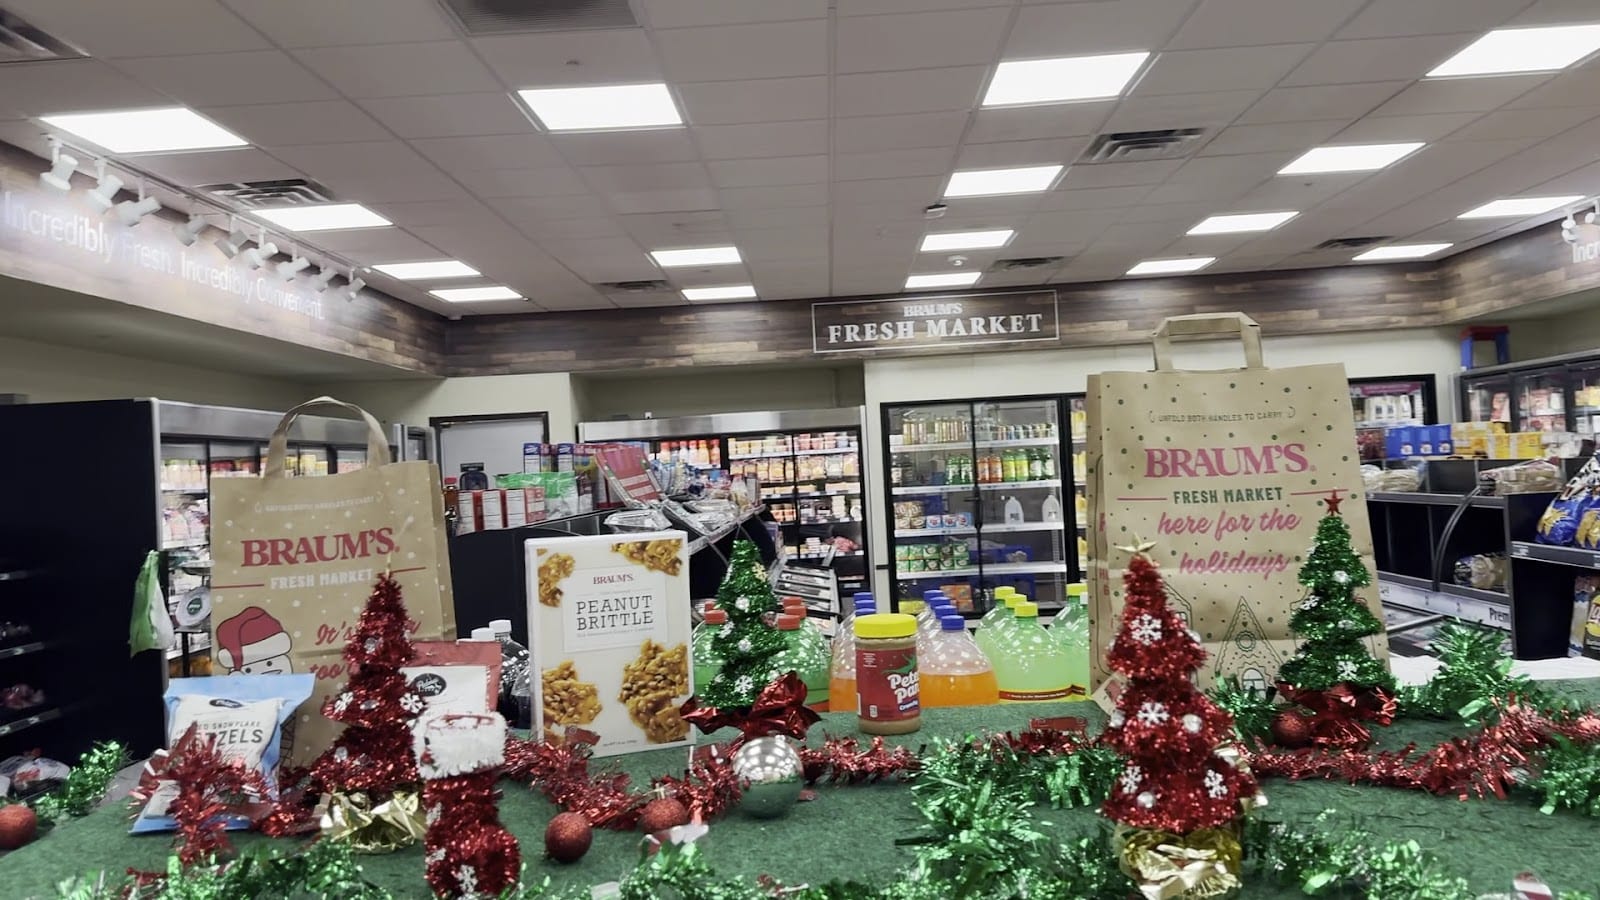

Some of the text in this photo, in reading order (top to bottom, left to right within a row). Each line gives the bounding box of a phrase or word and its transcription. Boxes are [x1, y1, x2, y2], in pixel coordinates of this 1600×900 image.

[4, 191, 114, 264] Incredibly
[181, 252, 253, 304] Incredibly
[904, 303, 963, 317] BRAUM'S
[828, 314, 1043, 343] FRESH MARKET
[1187, 414, 1206, 422] BOTH
[1208, 414, 1242, 422] HANDLES
[1144, 443, 1308, 478] BRAUM'S
[1173, 487, 1283, 504] FRESH MARKET
[1158, 507, 1302, 541] here for the
[241, 527, 394, 567] BRAUM'S
[1179, 549, 1290, 580] holidays
[270, 569, 373, 589] FRESH MARKET
[593, 573, 633, 585] BRAUM'S
[576, 595, 653, 615] PEANUT
[577, 611, 654, 631] BRITTLE
